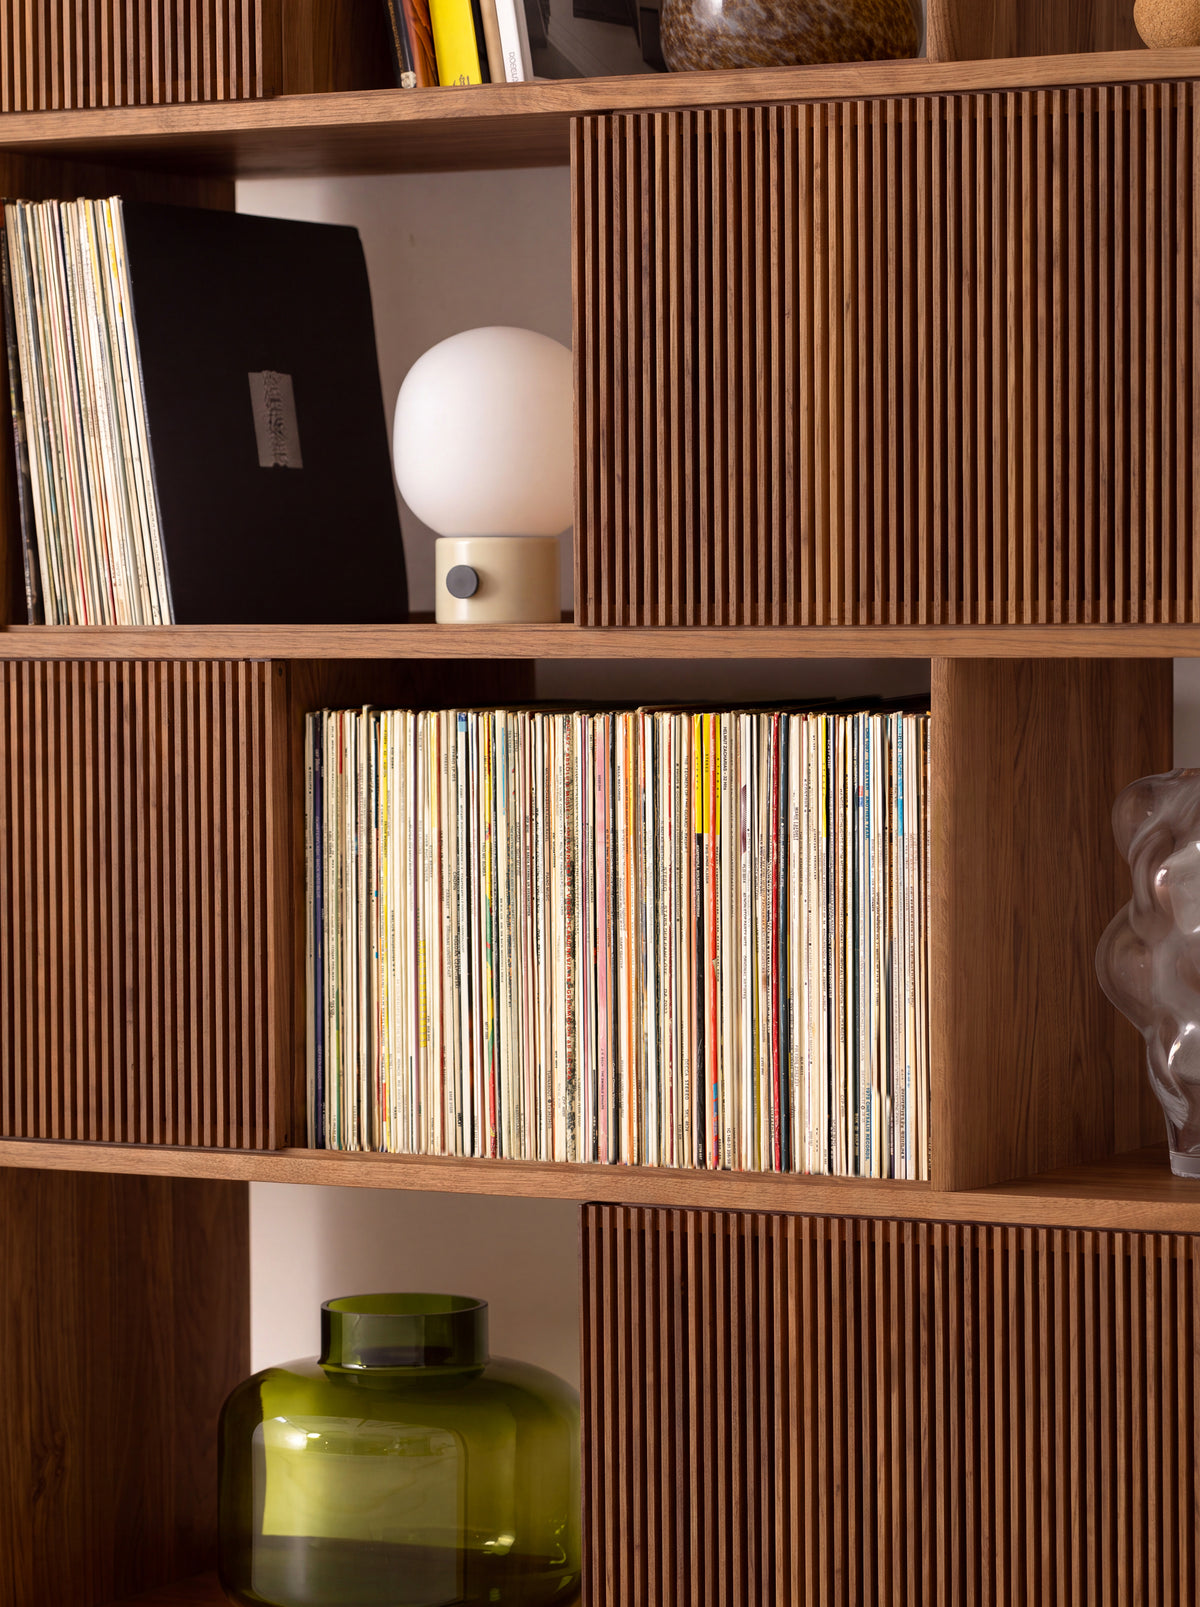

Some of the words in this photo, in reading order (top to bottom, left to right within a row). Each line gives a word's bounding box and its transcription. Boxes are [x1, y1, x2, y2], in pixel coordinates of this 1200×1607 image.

[566, 877, 571, 886] AB
[567, 974, 571, 983] AB
[567, 1040, 572, 1048] AB
